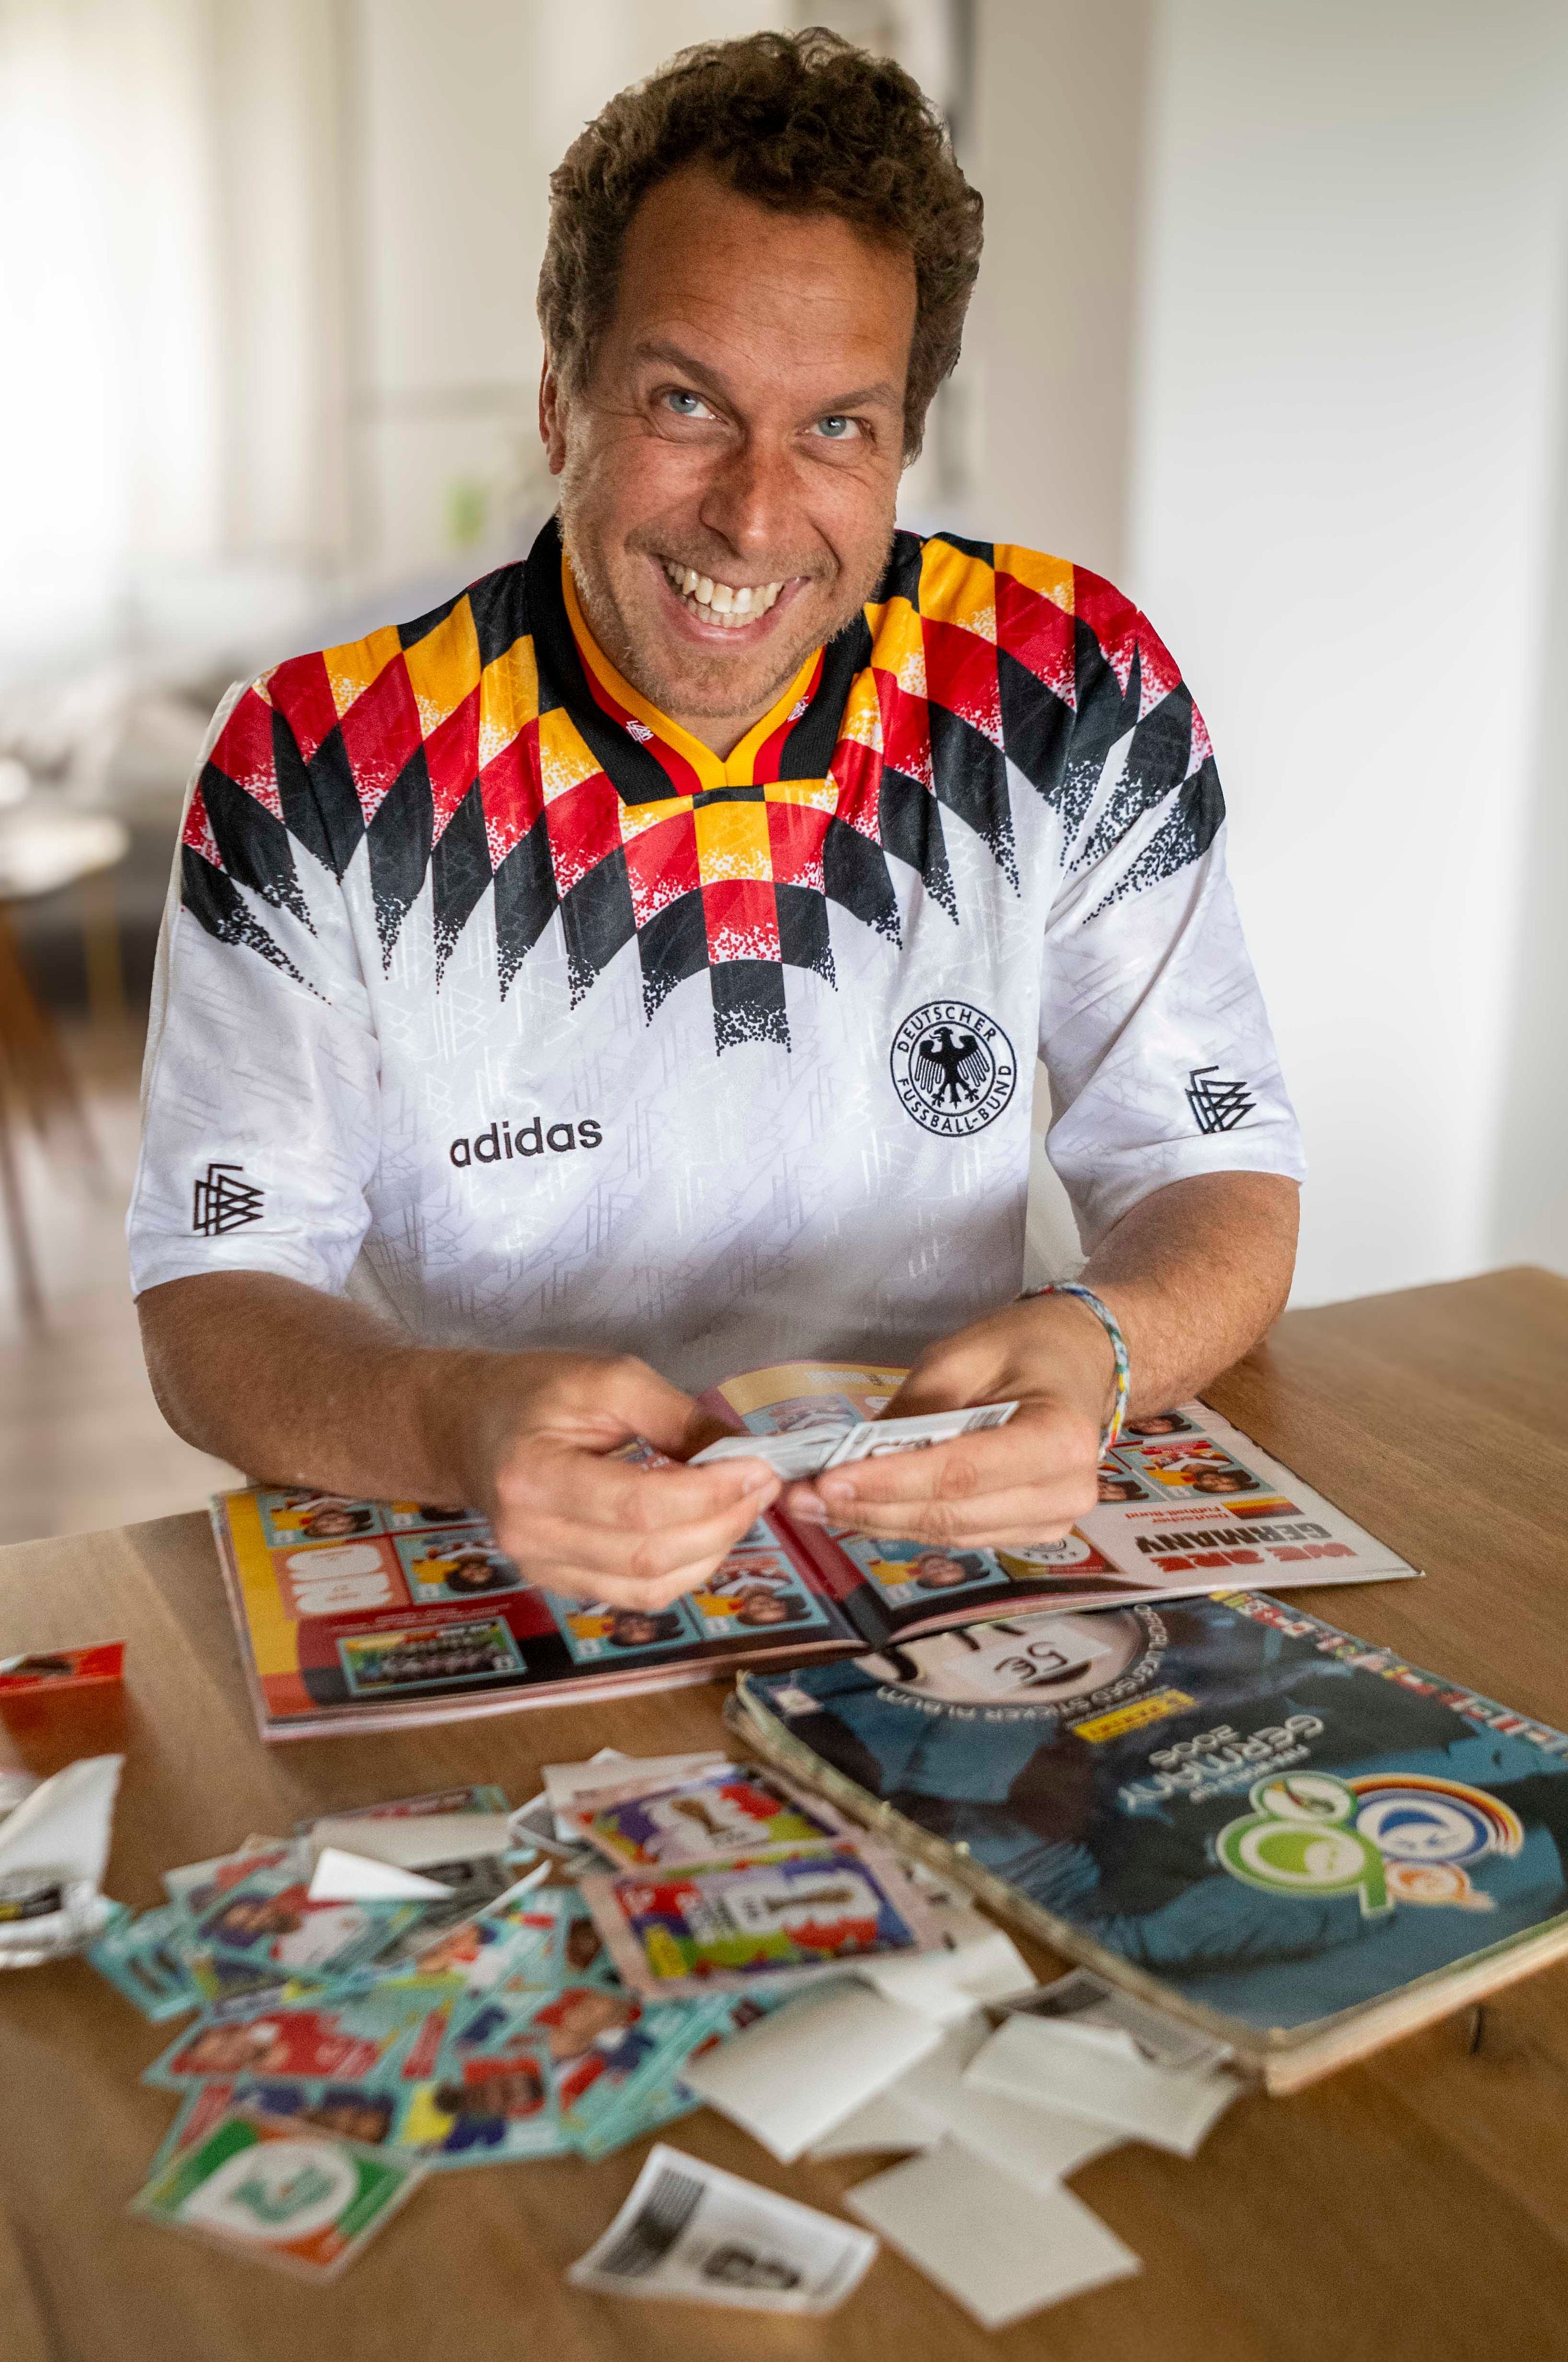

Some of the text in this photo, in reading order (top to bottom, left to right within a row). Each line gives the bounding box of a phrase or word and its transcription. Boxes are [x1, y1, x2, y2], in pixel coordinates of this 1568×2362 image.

[897, 1006, 996, 1053] DEUTSCHER
[897, 1065, 1011, 1133] FUSSBALL-BUND
[450, 1117, 603, 1167] adidas
[1134, 1523, 1332, 1554] GERMANY
